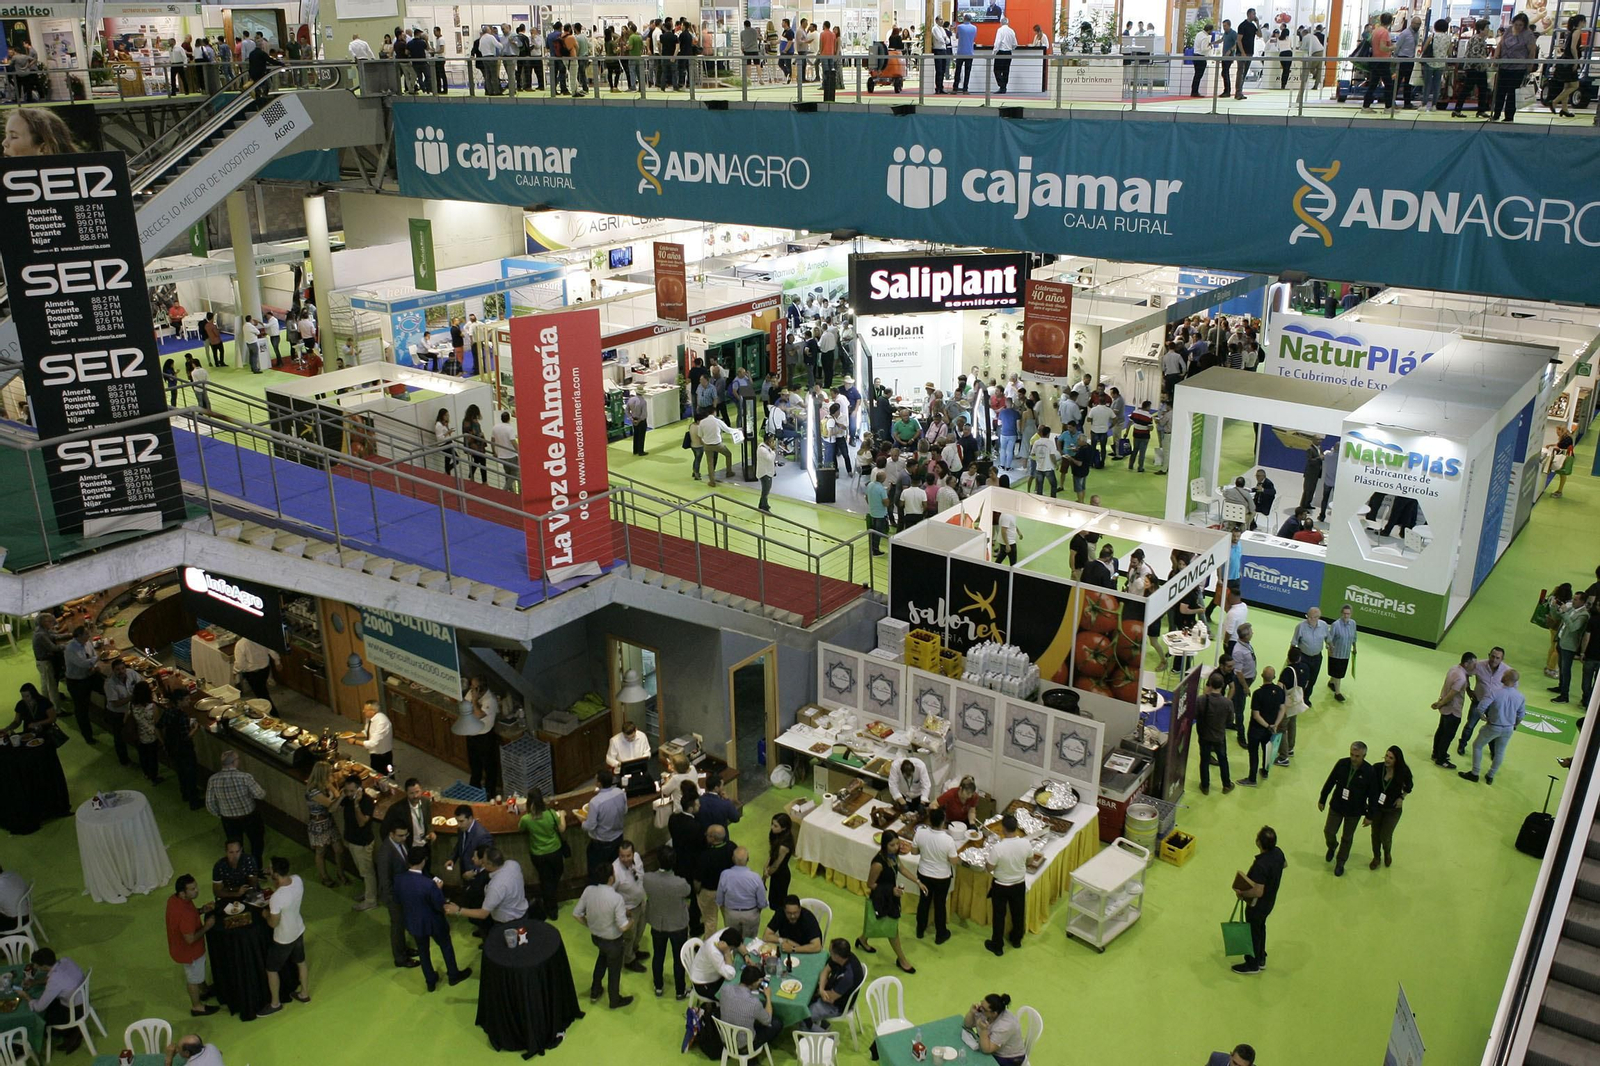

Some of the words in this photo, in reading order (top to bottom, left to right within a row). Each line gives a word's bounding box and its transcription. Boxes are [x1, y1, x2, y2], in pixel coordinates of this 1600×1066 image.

[274, 120, 296, 142] AGRO
[456, 132, 578, 181] cajamar
[664, 151, 811, 191] ADNAGRO
[3, 166, 117, 204] SER
[168, 204, 181, 220] LO
[180, 183, 208, 210] MEJOR
[208, 172, 221, 188] DE
[218, 140, 261, 178] NOSOTROS
[516, 174, 541, 188] CAJA
[542, 175, 576, 190] RURAL
[962, 156, 1183, 220] cajamar
[27, 207, 56, 216] Almería
[30, 222, 66, 231] Roquetas
[1063, 213, 1108, 231] CAJA
[1114, 216, 1173, 236] RURAL
[30, 230, 61, 238] Levante
[32, 237, 51, 245] Níjar
[80, 233, 96, 241] 88.8
[806, 260, 828, 271] Arnedo
[21, 258, 132, 296] SER
[870, 264, 1017, 303] Saliplant
[1032, 290, 1044, 300] 40
[1045, 292, 1066, 304] años
[1034, 284, 1063, 293] Celebramos
[44, 300, 74, 308] Almería
[46, 306, 80, 314] Poniente
[752, 298, 778, 310] Cummins
[944, 298, 1017, 308] semilleros
[47, 314, 83, 323] Roquetas
[50, 328, 68, 337] Níjar
[871, 324, 924, 338] Saliplant
[39, 348, 148, 386] SER
[534, 326, 564, 440] Almería
[1278, 366, 1291, 378] Te
[1294, 368, 1347, 386] Cubrimos
[1350, 376, 1364, 388] de
[62, 388, 91, 396] Almería
[63, 395, 96, 403] Poniente
[64, 402, 100, 411] Roquetas
[66, 408, 95, 416] Levante
[67, 416, 86, 424] Níjar
[57, 434, 162, 472] SER
[544, 442, 568, 478] de
[1364, 465, 1417, 484] Fabricantes
[1419, 474, 1431, 484] de
[1354, 474, 1394, 493] Plásticos
[1395, 482, 1440, 498] Agrícolas
[549, 479, 570, 532] Voz
[552, 532, 574, 566] La
[1168, 553, 1215, 602] DOMCA
[205, 574, 264, 610] InfoAgro
[1258, 582, 1291, 594] AGROFILMS
[1360, 606, 1397, 619] AGROTEXTIL
[363, 612, 394, 637] 2000
[908, 597, 1006, 646] sabores
